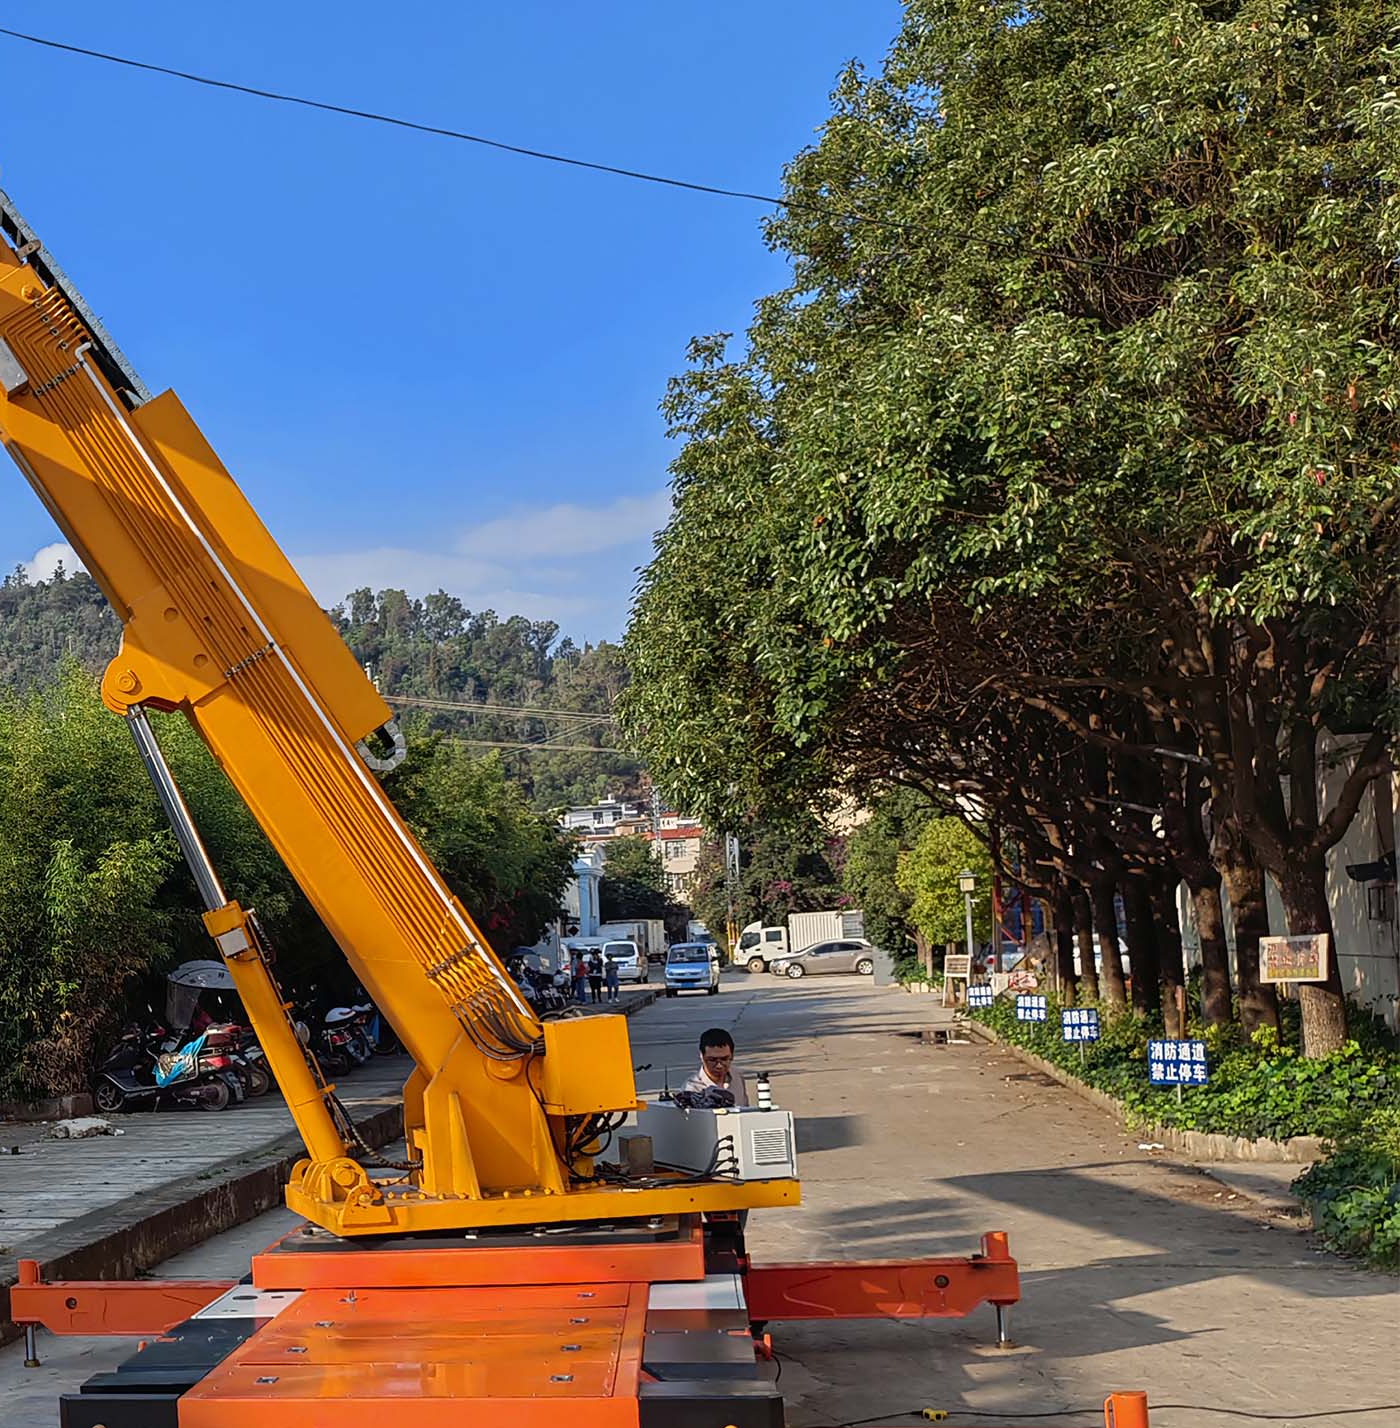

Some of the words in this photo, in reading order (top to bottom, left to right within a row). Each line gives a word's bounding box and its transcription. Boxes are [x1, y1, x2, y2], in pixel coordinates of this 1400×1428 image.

[1150, 1042, 1206, 1061] 消防通道
[1151, 1062, 1207, 1082] 禁止停车
